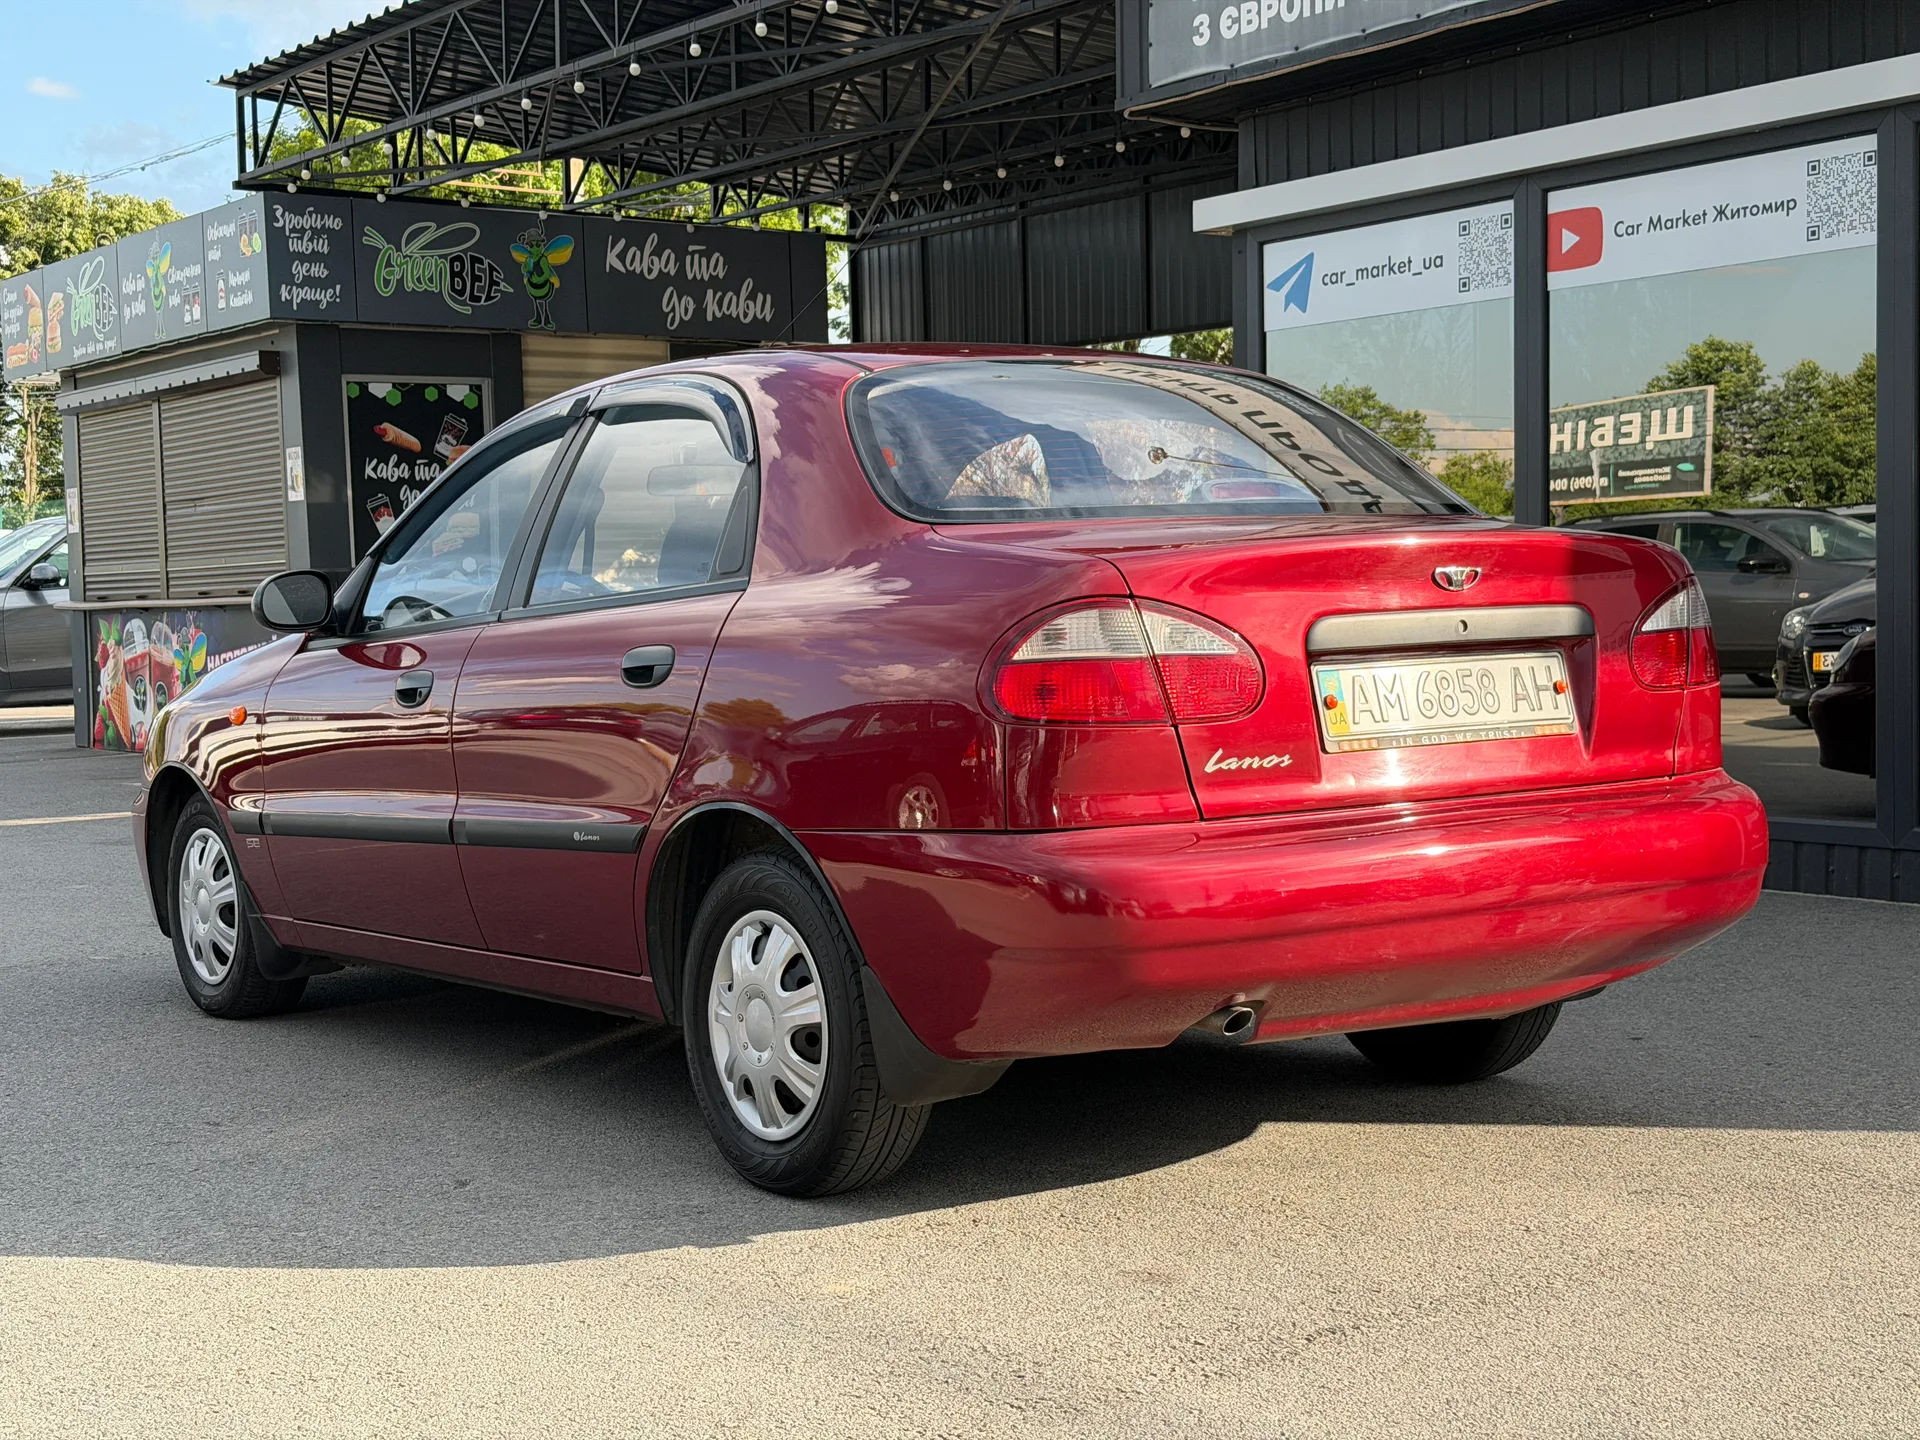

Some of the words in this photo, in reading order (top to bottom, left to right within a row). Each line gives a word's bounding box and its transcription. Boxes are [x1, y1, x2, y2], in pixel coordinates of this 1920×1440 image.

[1192, 13, 1211, 47] З
[272, 204, 344, 237] Зробимо
[1613, 220, 1643, 238] Car
[1647, 208, 1708, 234] Market
[1712, 197, 1798, 223] Житомир
[288, 229, 331, 255] твій
[606, 232, 680, 280] Кава
[685, 244, 729, 282] та
[291, 260, 330, 284] день
[1321, 254, 1444, 287] car_market_ua
[279, 283, 342, 311] краще!
[662, 285, 697, 331] до
[702, 277, 776, 324] кави
[364, 453, 412, 483] Кава
[414, 459, 442, 481] та
[1352, 672, 1410, 726] AM
[1416, 668, 1501, 720] 6858
[1510, 664, 1560, 713] AH
[1328, 712, 1348, 726] UA
[1400, 737, 1413, 746] IN
[1421, 735, 1448, 745] GOD
[1455, 732, 1472, 742] WE
[1480, 729, 1518, 740] TRUST
[1203, 747, 1293, 774] Lanos
